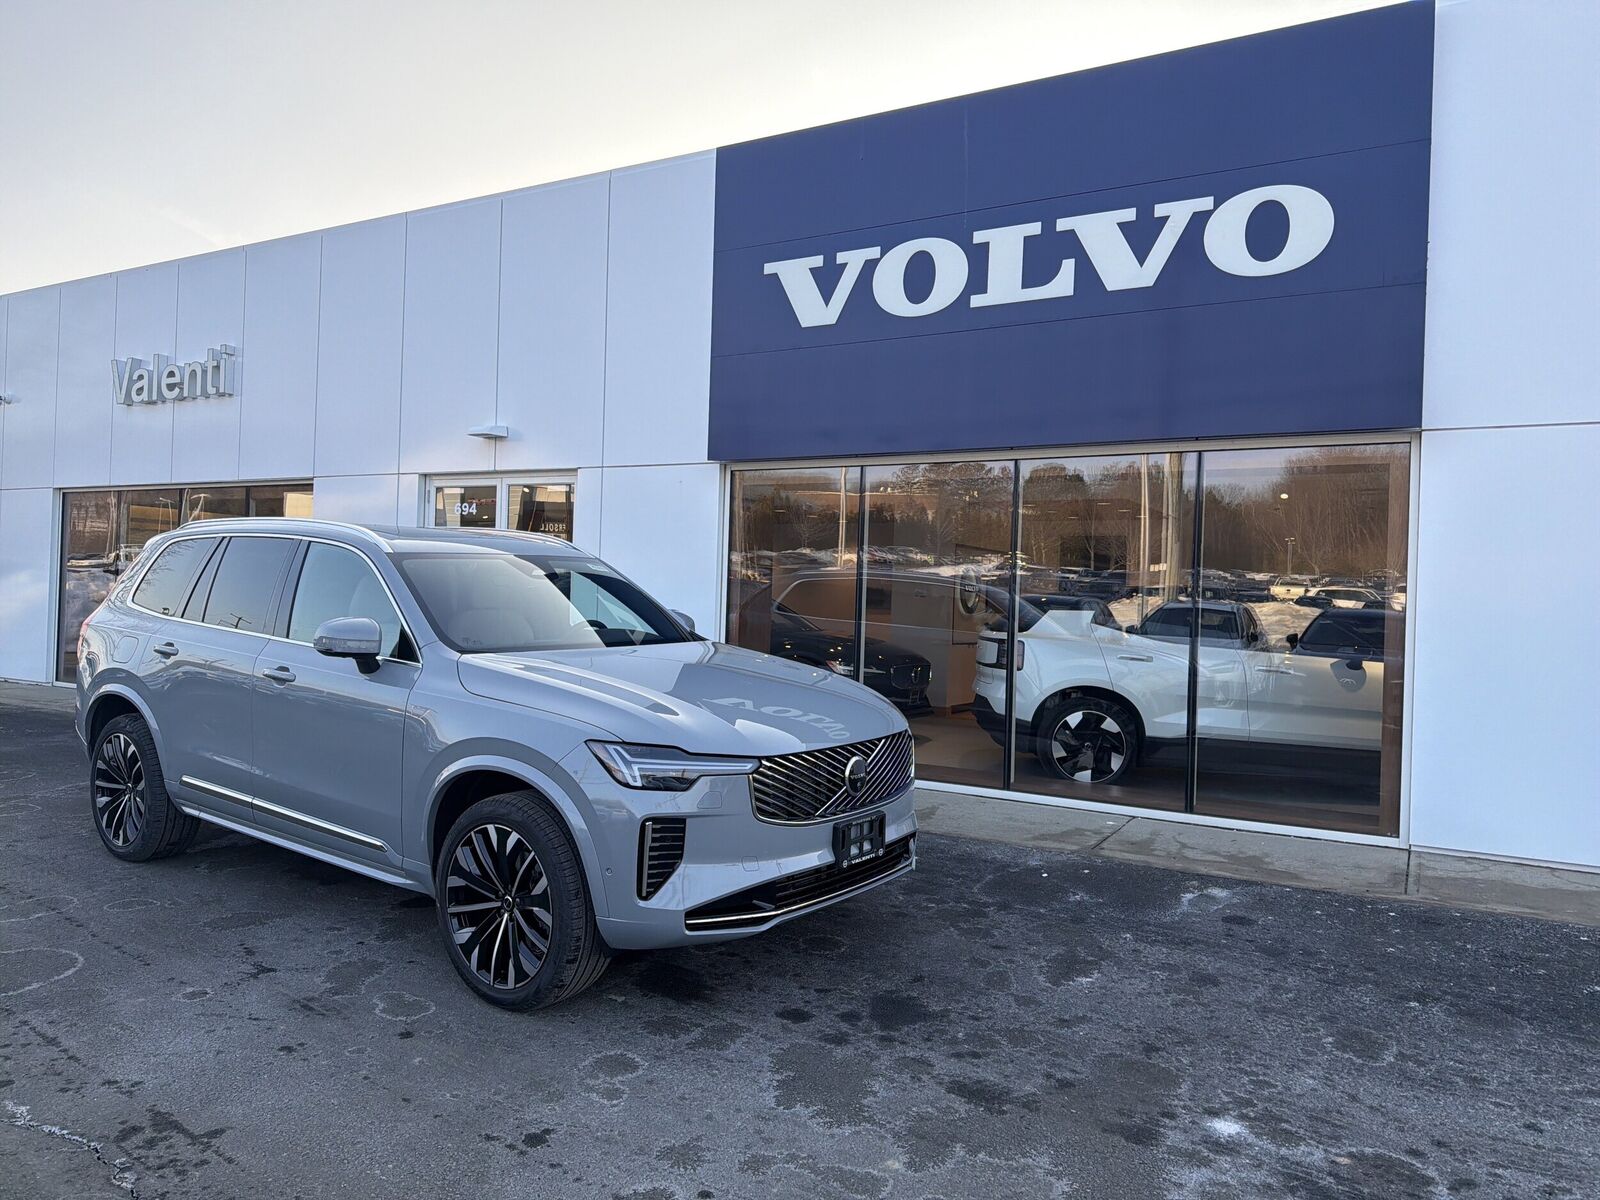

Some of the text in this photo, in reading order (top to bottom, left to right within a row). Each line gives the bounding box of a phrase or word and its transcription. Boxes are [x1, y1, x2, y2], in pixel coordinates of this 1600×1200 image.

[763, 184, 1335, 328] VOLVO
[110, 344, 237, 405] Valenti
[454, 502, 477, 515] 694
